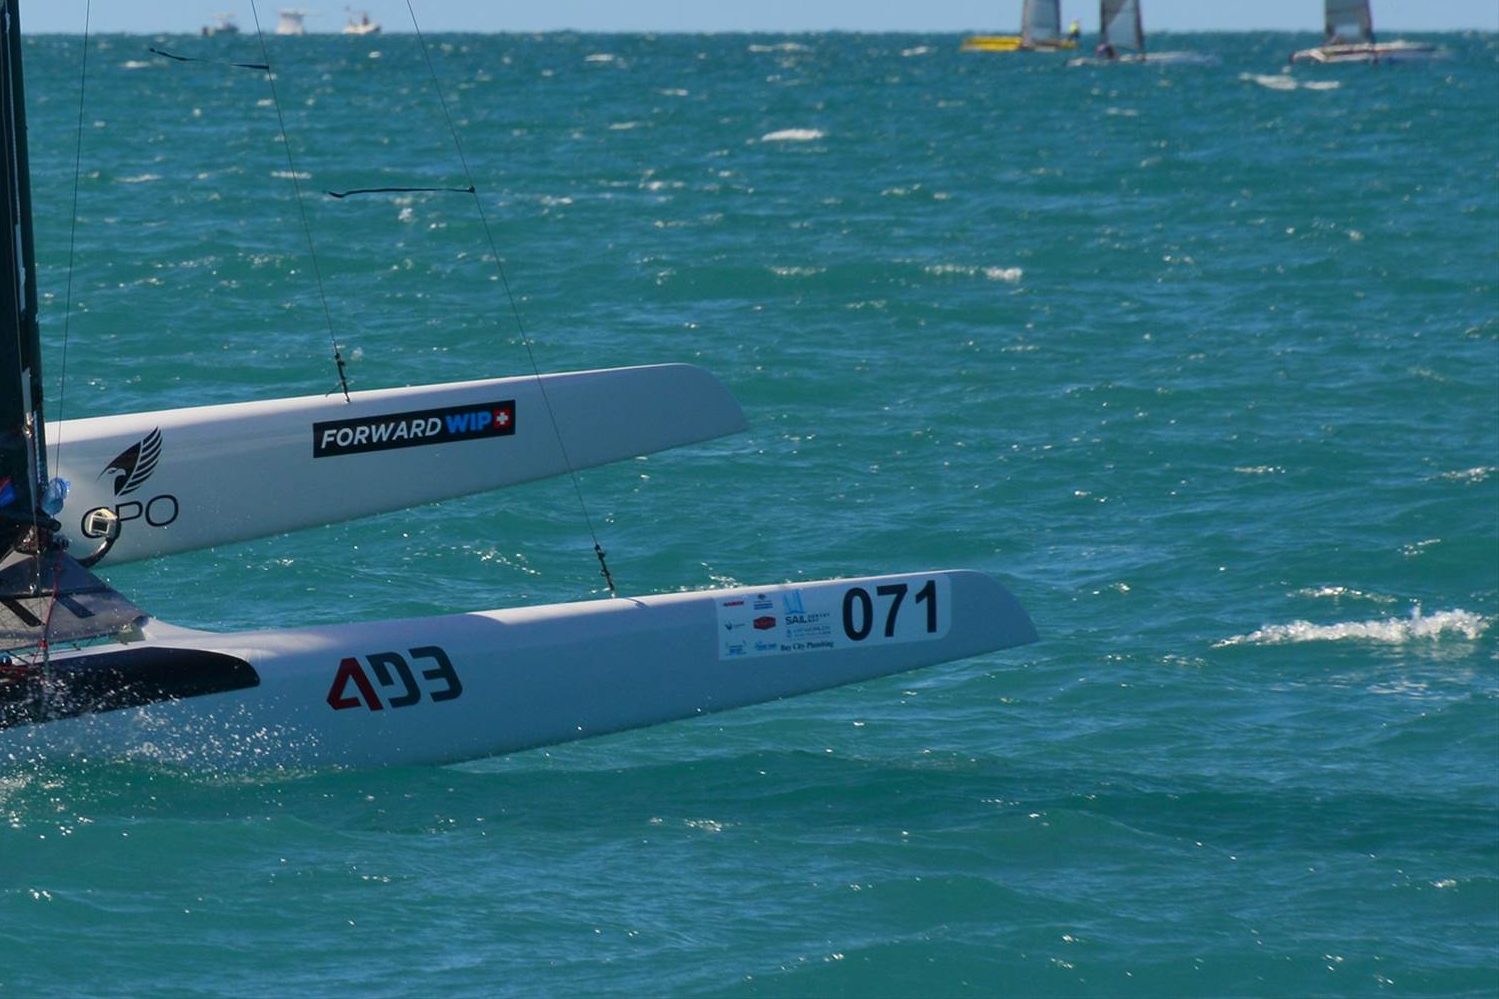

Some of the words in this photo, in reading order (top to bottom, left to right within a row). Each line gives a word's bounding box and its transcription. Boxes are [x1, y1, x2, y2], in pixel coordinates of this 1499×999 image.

[321, 417, 442, 449] FORWARD
[445, 410, 492, 434] WIP
[785, 615, 807, 625] SAIL
[842, 579, 937, 642] 071
[326, 645, 463, 711] AD3
